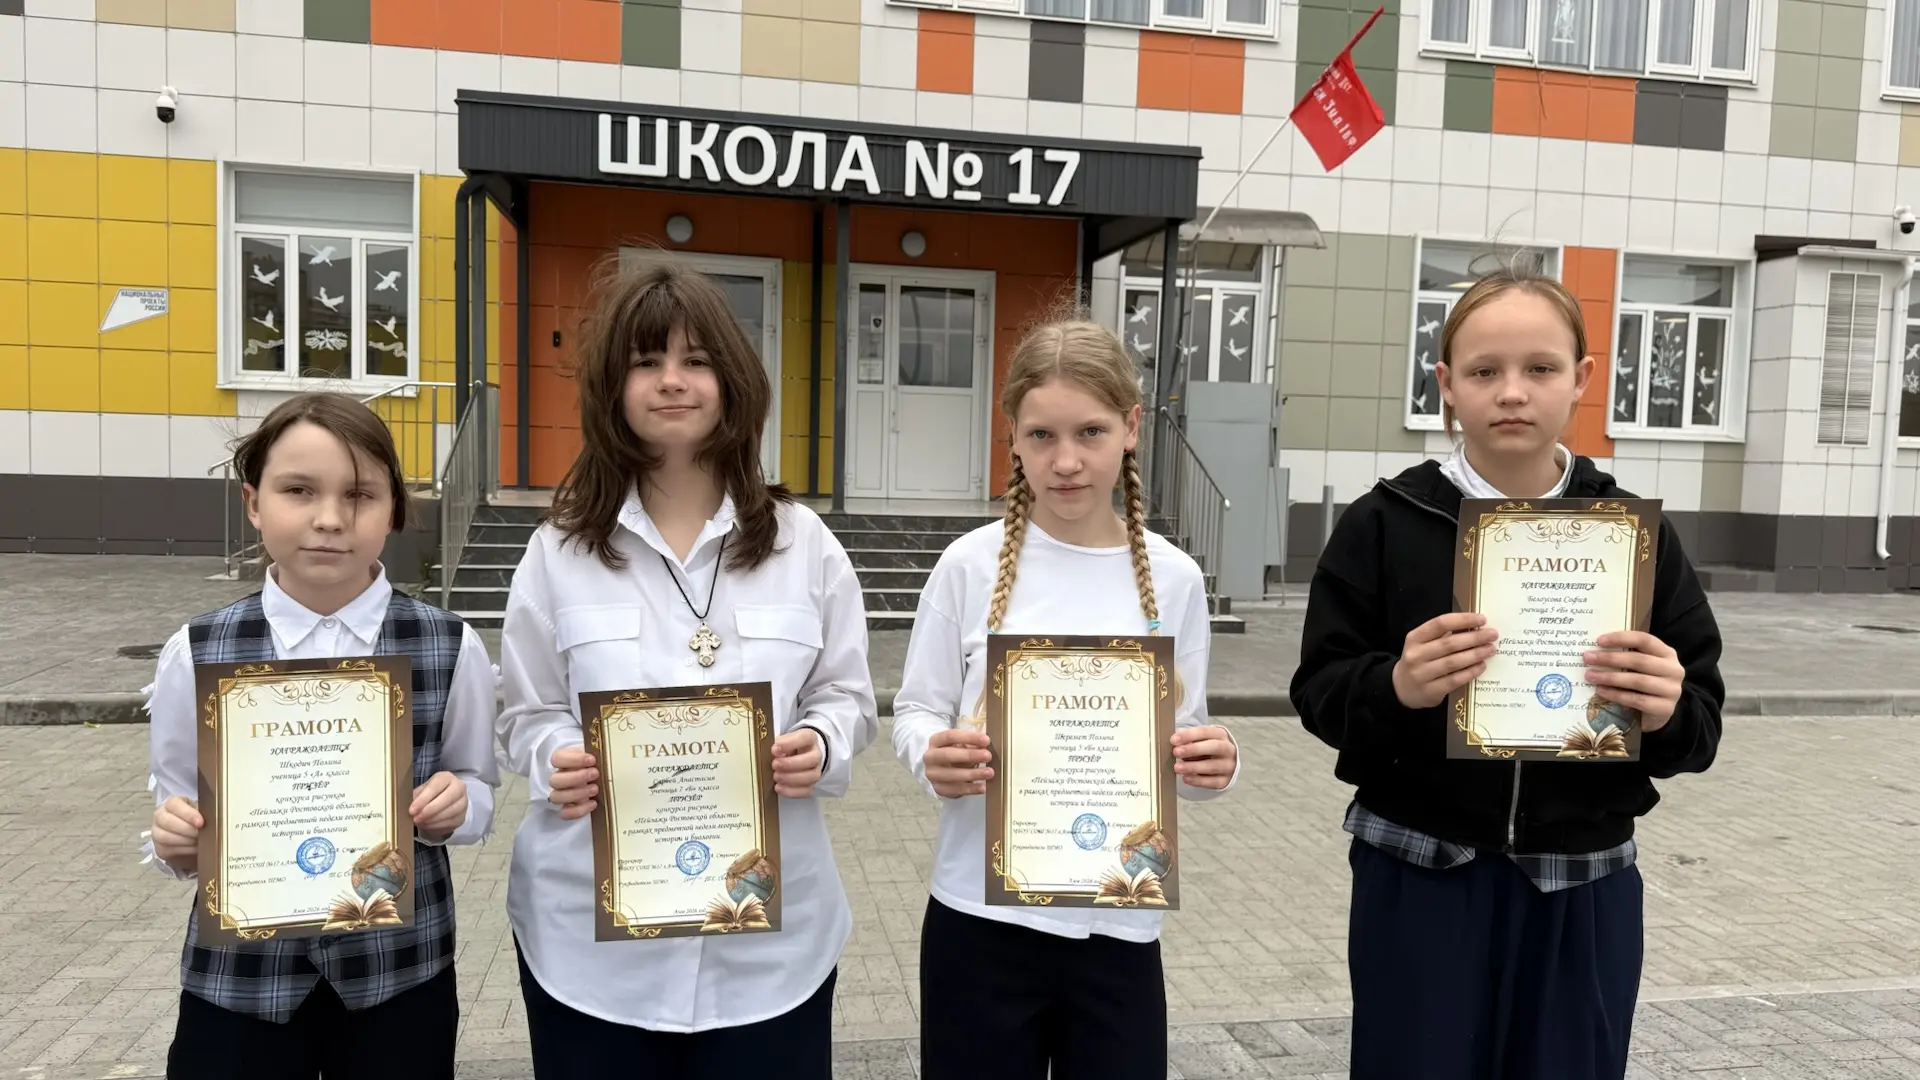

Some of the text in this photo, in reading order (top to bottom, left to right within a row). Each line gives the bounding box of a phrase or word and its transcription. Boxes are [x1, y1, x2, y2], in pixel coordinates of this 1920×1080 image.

[598, 113, 1081, 206] ШКОЛА № 17
[121, 290, 165, 299] НАЦИОНАЛЬНЫЕ
[140, 297, 166, 305] ПРОЕКТЫ
[1502, 557, 1608, 573] ГРАМОТА
[1520, 581, 1597, 591] НАГРАЖДАЕТСЯ
[1527, 595, 1588, 606] Белоусова София
[1519, 606, 1549, 616] ученица
[1538, 616, 1574, 625] ПРИЗЁР
[1523, 628, 1589, 638] конкурса рисунков
[1535, 638, 1577, 647] Ростовской
[1578, 639, 1598, 647] облас
[1518, 648, 1560, 658] предметной
[1517, 660, 1548, 668] истории
[1031, 694, 1130, 711] ГРАМОТА
[250, 717, 363, 739] ГРАМОТА
[1049, 719, 1121, 728] НАГРАЖДАЕТСЯ
[1088, 733, 1115, 741] Полина
[270, 742, 352, 756] НАГРАЖДАЕТСЯ
[631, 739, 730, 759] ГРАМОТА
[1048, 745, 1076, 753] ученица
[1097, 745, 1119, 753] класса
[313, 759, 342, 767] Полина
[1068, 754, 1102, 763] ПРИЗЁР
[647, 762, 720, 774] НАГРАЖДАЕТСЯ
[1053, 767, 1116, 775] конкурса рисунков
[269, 773, 302, 783] ученица
[303, 770, 309, 779] 5
[326, 769, 350, 778] класса
[1031, 776, 1065, 786] «Пейзажи
[1065, 777, 1105, 786] Ростовской
[291, 780, 331, 791] ПРИЗЁР
[650, 788, 678, 796] ученица
[698, 784, 720, 792] класса
[1023, 789, 1050, 797] рамках
[1050, 787, 1091, 797] предметной
[1091, 788, 1113, 796] недели
[275, 792, 346, 805] конкурса рисунков
[668, 794, 703, 803] ПРИЗЁР
[249, 801, 371, 817] «Пейзажи Ростовской области»
[656, 803, 718, 814] конкурса рисунков
[1050, 800, 1079, 808] истории
[241, 819, 271, 831] рамках
[271, 816, 318, 828] предметной
[319, 814, 344, 823] недели
[344, 811, 384, 823] географии,
[634, 811, 740, 825] «Пейзажи Ростовской области»
[271, 830, 304, 840] истории
[627, 827, 654, 837] рамках
[654, 824, 694, 836] предметной
[695, 823, 716, 831] недели
[654, 836, 683, 845] истории
